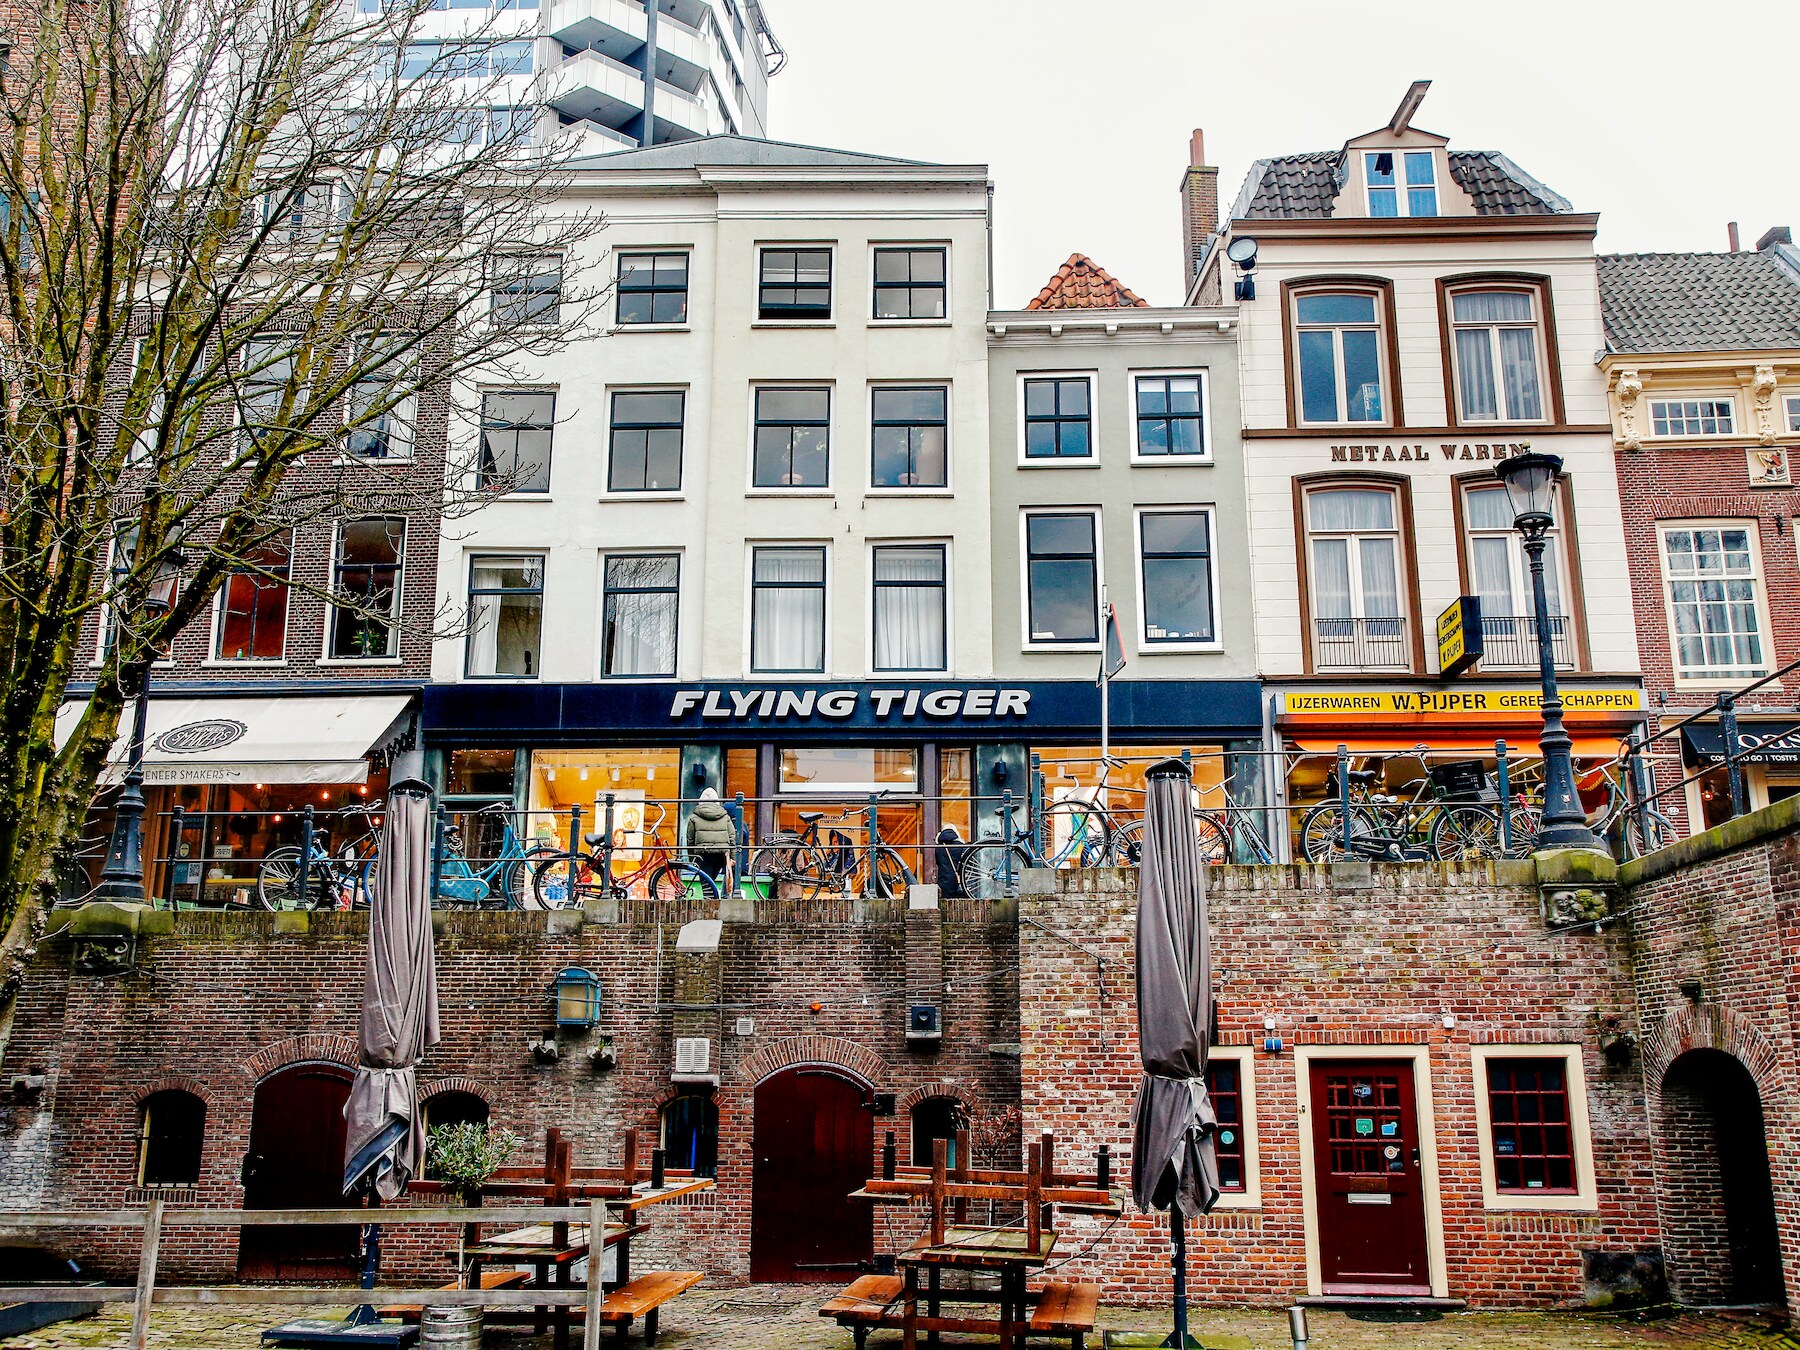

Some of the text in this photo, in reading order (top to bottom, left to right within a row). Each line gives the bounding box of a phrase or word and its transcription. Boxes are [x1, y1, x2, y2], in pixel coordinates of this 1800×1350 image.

[1331, 444, 1524, 461] METAAL WAREN
[670, 689, 1031, 717] FLYING TIGER
[1292, 697, 1381, 709] IJZERWAREN
[1499, 694, 1634, 707] GEREESCHAPPEN
[172, 730, 231, 747] SMAKERS
[1750, 754, 1763, 762] GO
[1769, 754, 1798, 762] TOSTI'S
[179, 769, 224, 780] SMAKERS
